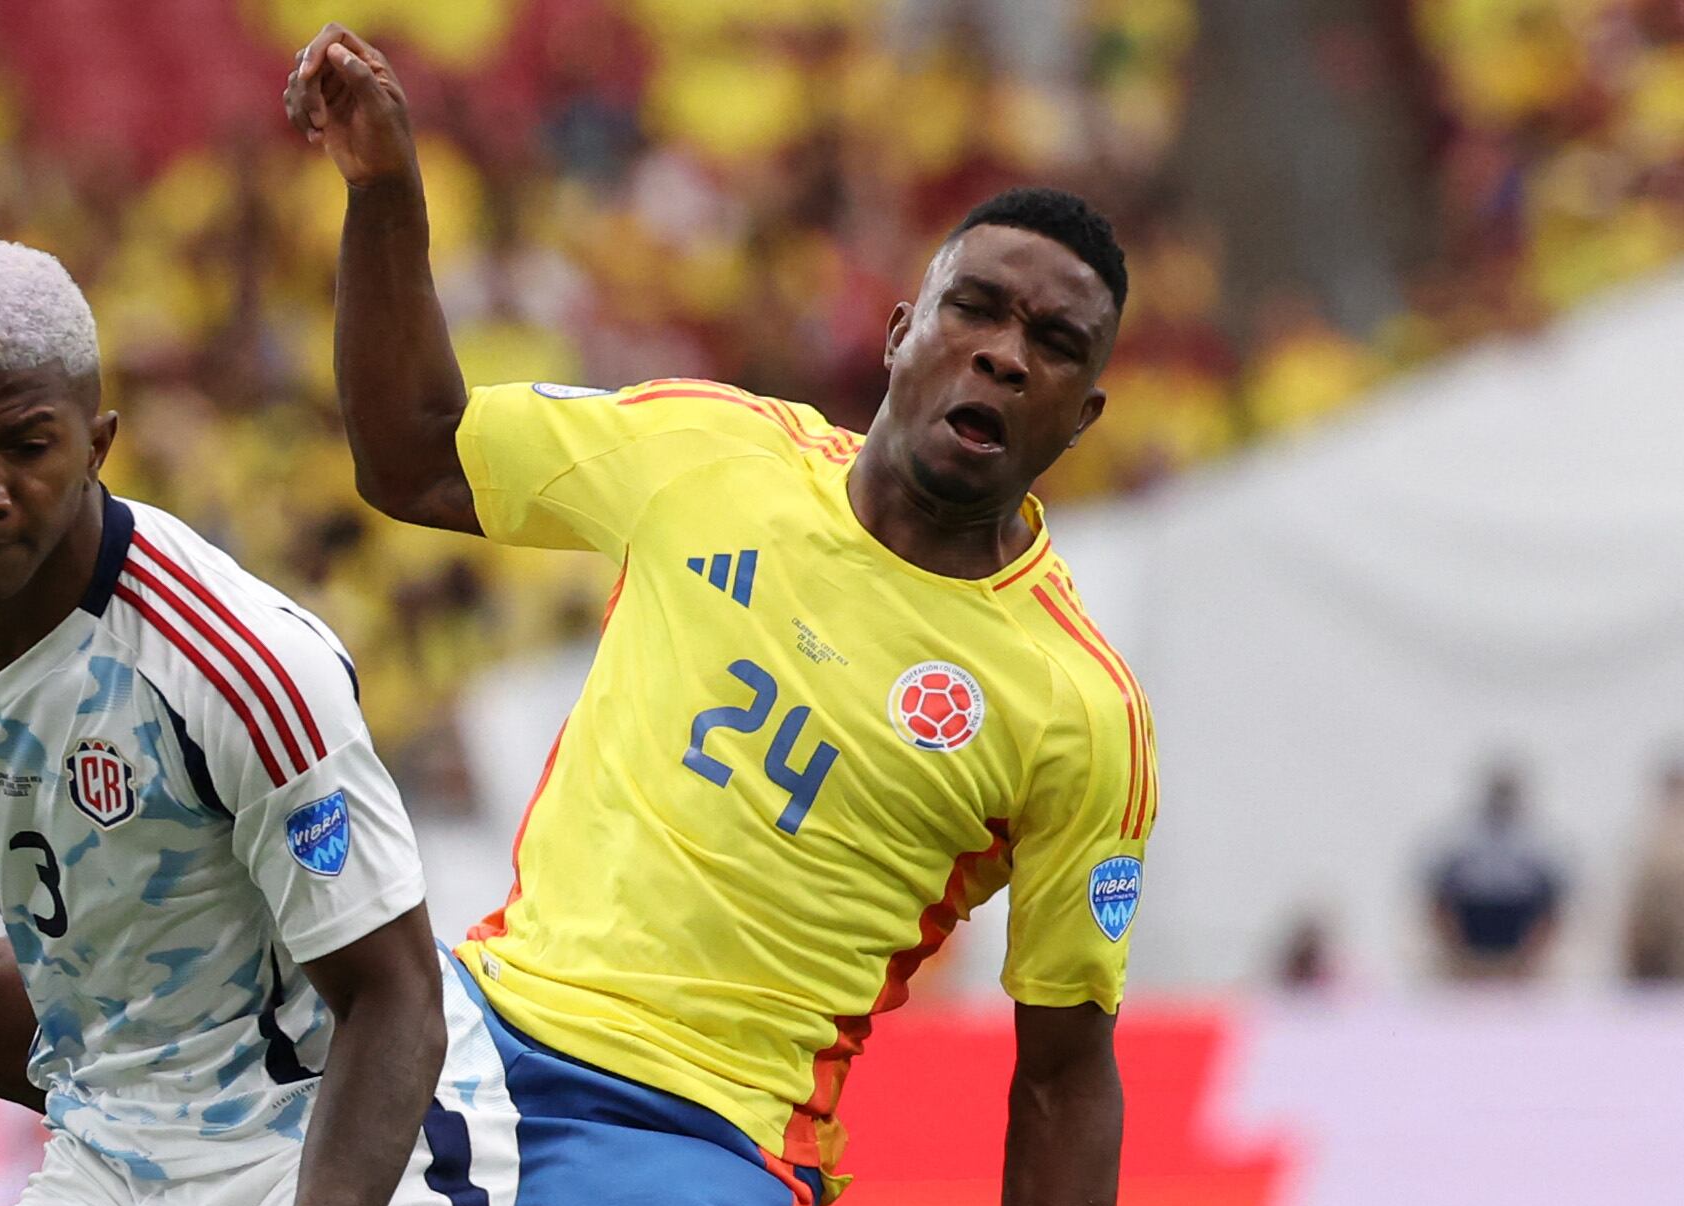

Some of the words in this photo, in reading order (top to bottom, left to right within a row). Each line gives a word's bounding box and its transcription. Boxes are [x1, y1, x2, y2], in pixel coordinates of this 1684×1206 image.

[682, 659, 841, 837] 24
[81, 756, 122, 814] CR
[294, 807, 342, 847] VIBRA
[9, 830, 68, 939] 3
[1095, 876, 1137, 896] VIBRA
